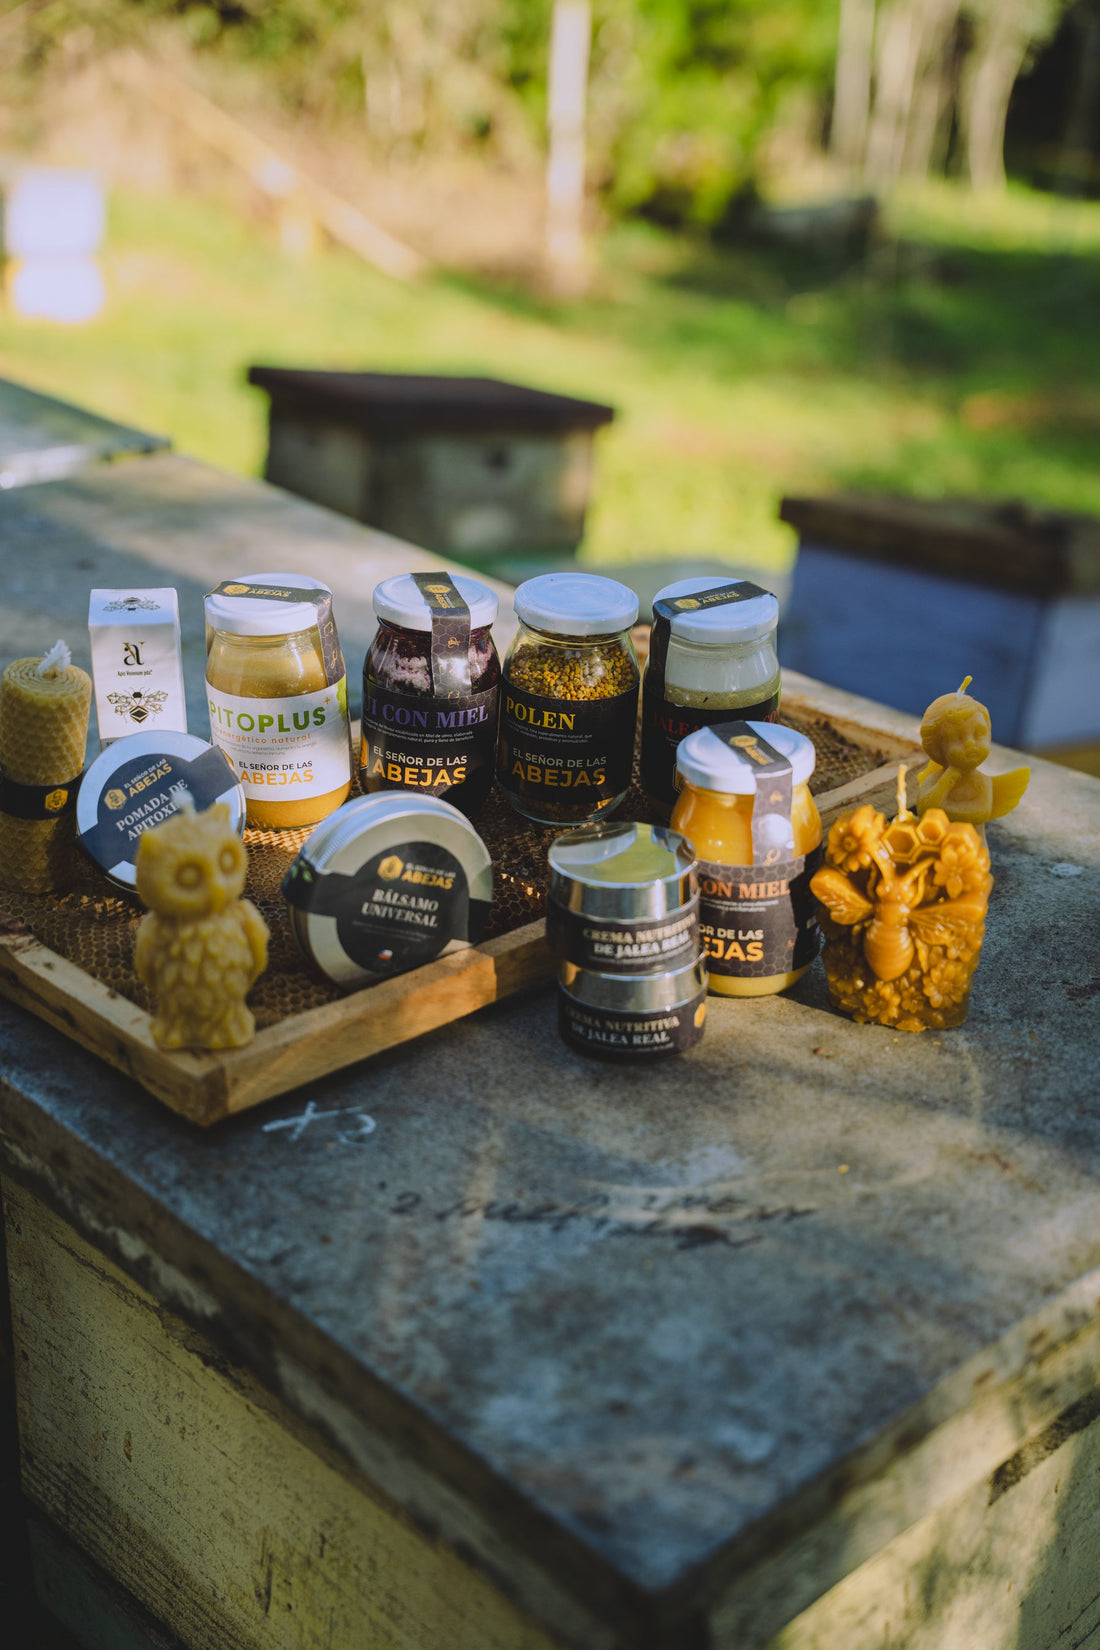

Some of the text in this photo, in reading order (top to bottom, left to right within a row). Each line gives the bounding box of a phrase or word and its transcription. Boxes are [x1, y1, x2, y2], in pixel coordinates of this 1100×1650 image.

[382, 703, 429, 728] CON
[436, 704, 489, 729] MIEL
[506, 696, 576, 731] POLEN
[271, 733, 311, 744] natural
[238, 761, 248, 769] EL
[249, 762, 279, 771] SEÑOR
[296, 760, 313, 769] LAS
[373, 745, 467, 767] EL SEÑOR DE LAS
[513, 747, 607, 768] EL SEÑOR DE LAS
[128, 763, 172, 797] ABEJAS
[240, 769, 314, 786] ABEJAS
[372, 758, 467, 787] ABEJAS
[511, 760, 606, 788] ABEJAS
[115, 779, 188, 832] POMADA DE
[127, 802, 178, 840] APITOXI
[401, 869, 455, 890] ABEJAS
[738, 879, 791, 899] MIEL
[372, 888, 439, 912] BÁLSAMO
[361, 902, 438, 928] UNIVERSAL
[717, 928, 736, 939] DE
[738, 929, 764, 941] LAS
[605, 1015, 680, 1032] NUTRITIVA
[587, 1028, 628, 1045] JALEA
[632, 1031, 671, 1045] REAL
